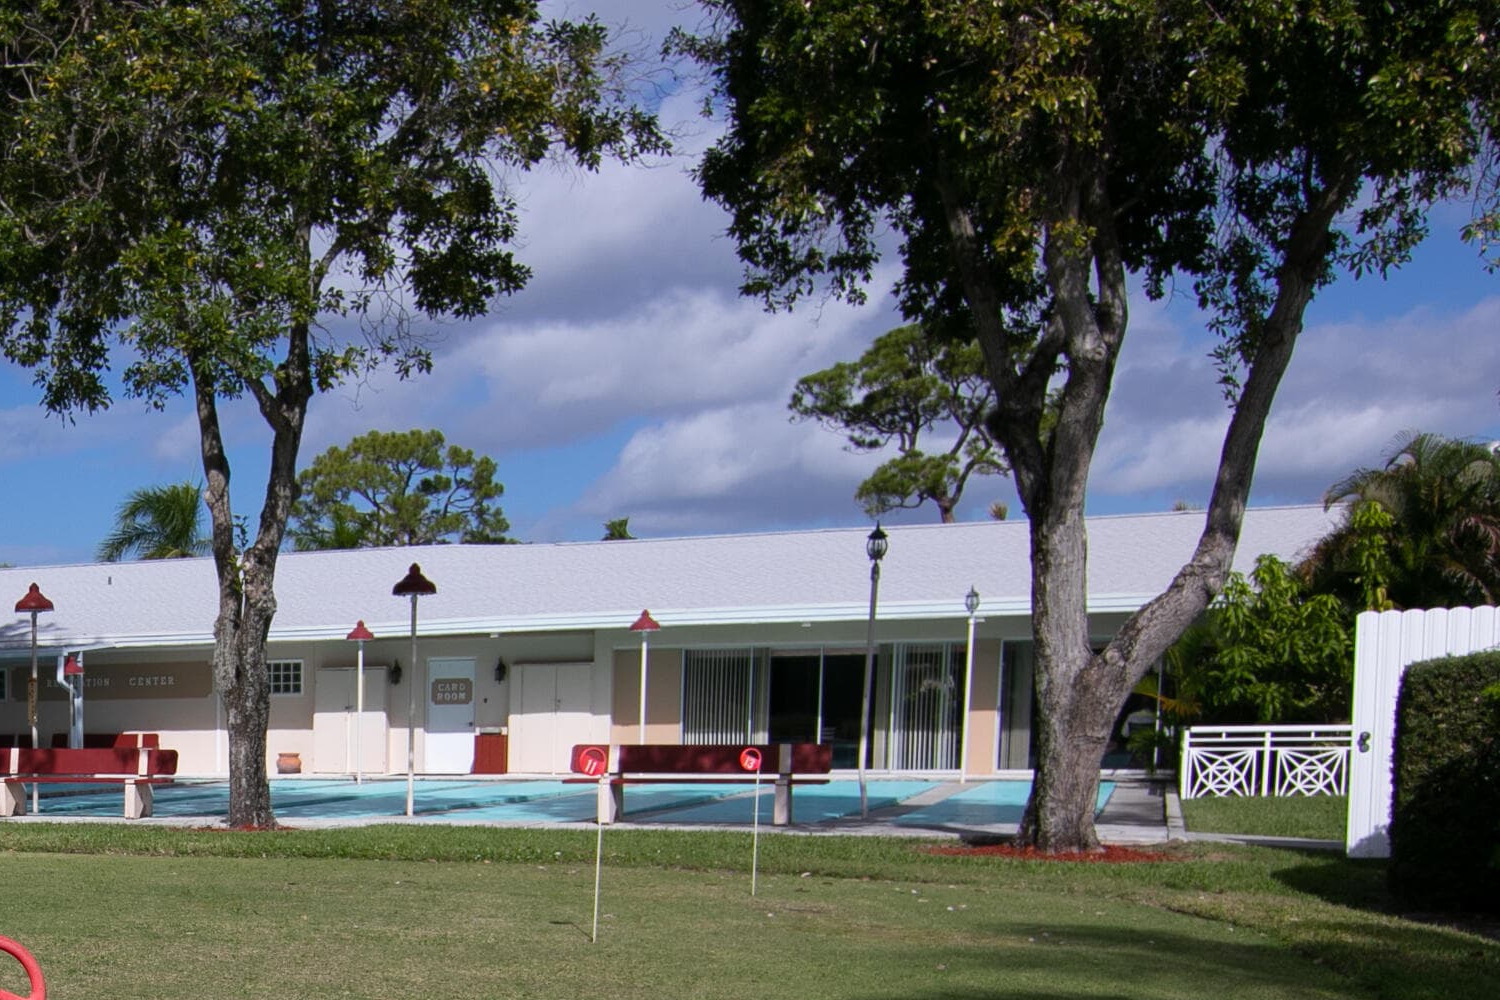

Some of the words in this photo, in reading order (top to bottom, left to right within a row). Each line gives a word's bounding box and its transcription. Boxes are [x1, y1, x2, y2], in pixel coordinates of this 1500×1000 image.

[46, 678, 111, 688] RETION
[128, 675, 175, 687] CENTER
[438, 683, 466, 692] CARD
[437, 692, 466, 701] ROOM
[584, 758, 598, 775] 11
[743, 756, 756, 769] 13
